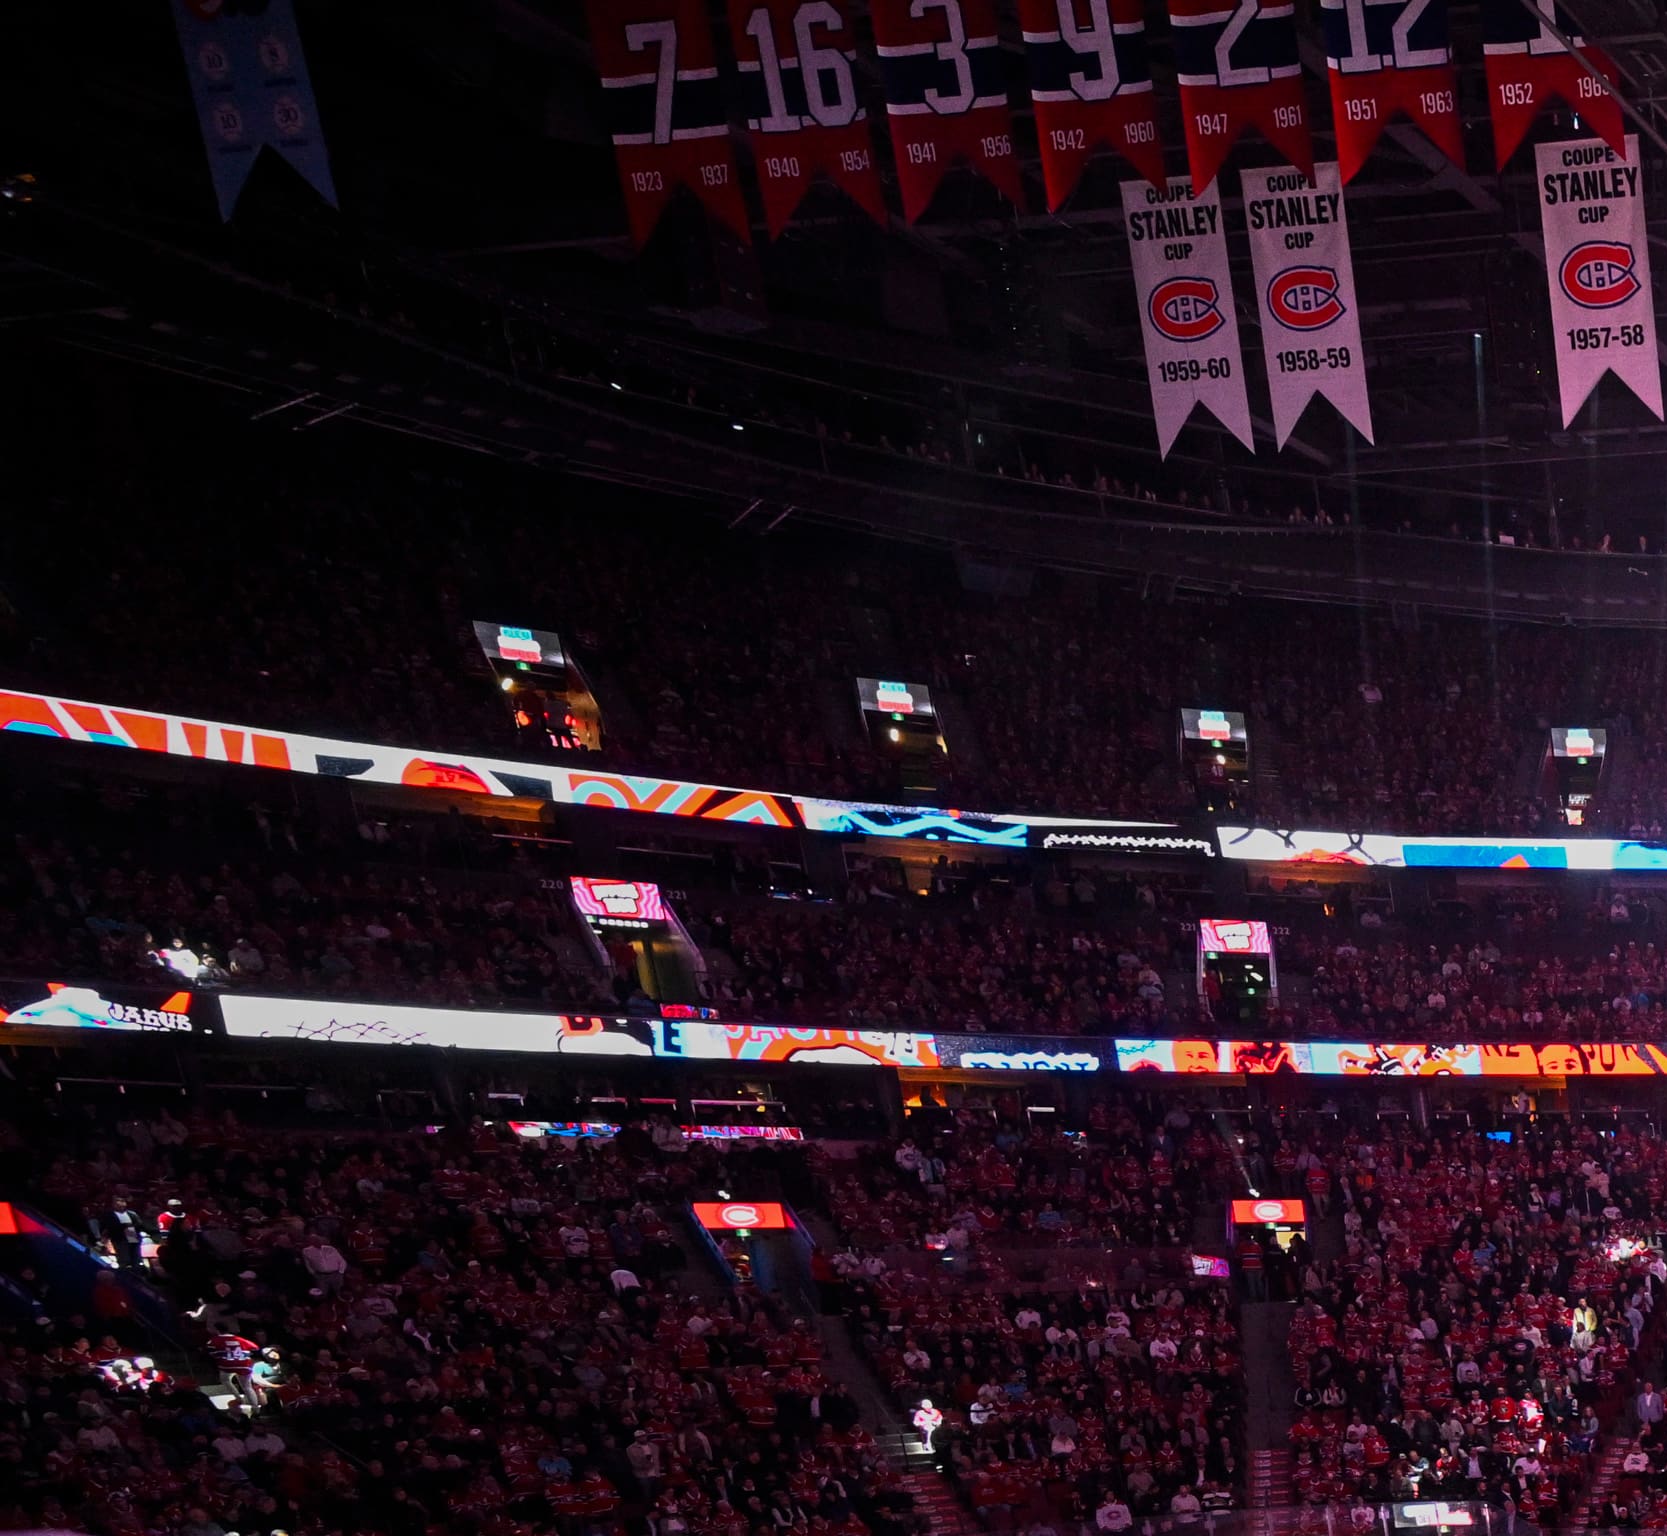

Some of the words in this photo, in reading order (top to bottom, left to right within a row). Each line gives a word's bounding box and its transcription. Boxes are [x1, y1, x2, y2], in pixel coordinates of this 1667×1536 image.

[910, 0, 974, 115] 3
[1057, 0, 1120, 100] 9
[746, 1, 856, 132] 16
[625, 20, 676, 144] 7
[1499, 83, 1534, 106] 1952
[1195, 114, 1228, 136] 1947
[1272, 105, 1302, 129] 1961
[1344, 99, 1378, 121] 1951
[1419, 91, 1454, 114] 1963
[906, 142, 936, 164] 1941
[981, 134, 1011, 158] 1956
[1050, 129, 1086, 151] 1942
[1123, 121, 1154, 144] 1960
[764, 157, 799, 178] 1940
[839, 149, 870, 172] 1954
[1562, 146, 1614, 166] COUPE
[631, 171, 663, 193] 1923
[700, 164, 728, 186] 1937
[1267, 174, 1315, 193] COUP
[1544, 167, 1638, 205] STANLEY
[1130, 205, 1217, 241] STANLEY
[1250, 193, 1340, 229] STANLEY
[1578, 206, 1610, 224] CUP
[1164, 243, 1193, 261] CUP
[1284, 232, 1314, 250] CUP
[1567, 325, 1645, 350] 1957-58
[1158, 357, 1231, 382] 1959-60
[1276, 347, 1351, 373] 1958-59
